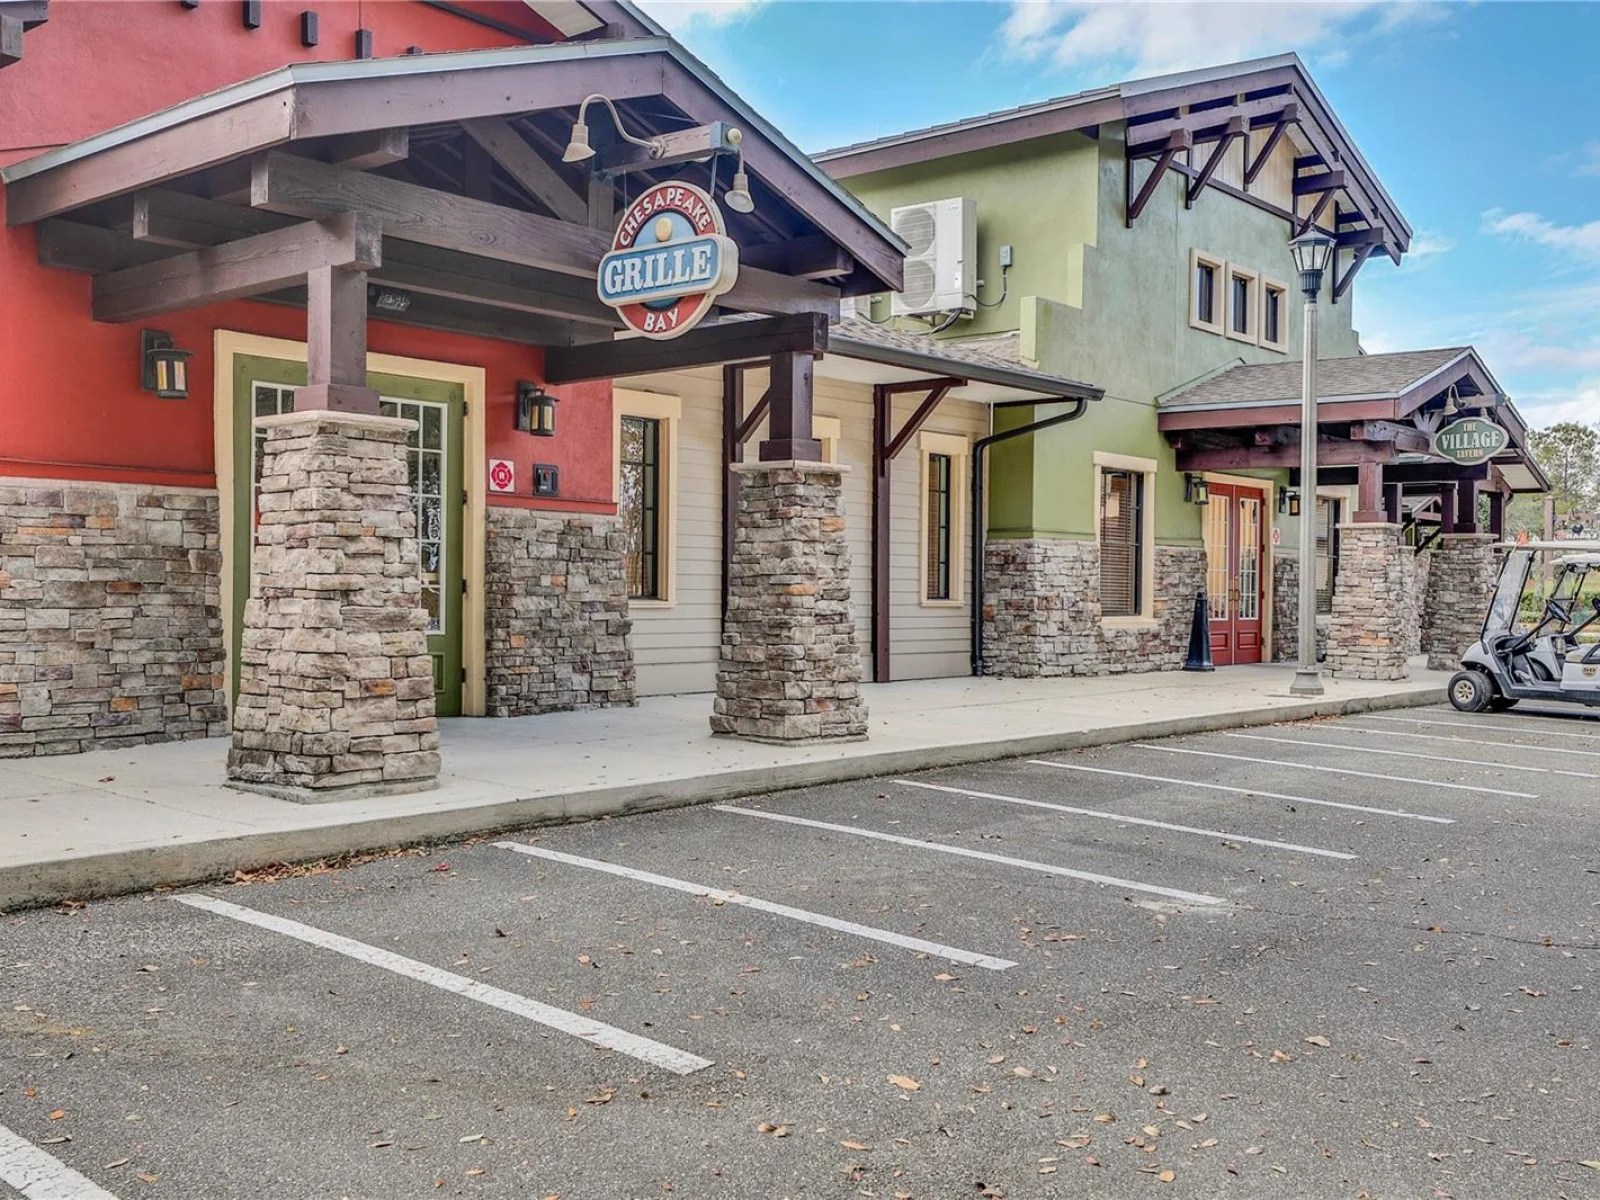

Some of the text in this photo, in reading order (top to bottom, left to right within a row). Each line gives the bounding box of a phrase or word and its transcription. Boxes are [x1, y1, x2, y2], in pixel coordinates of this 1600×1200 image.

[620, 188, 711, 246] CHESAPEAKE
[604, 245, 712, 294] GRILLE
[644, 307, 679, 331] BAY
[1463, 423, 1476, 431] THE
[1441, 431, 1500, 449] VILLAGE
[1456, 449, 1484, 458] TAVERN
[499, 471, 505, 480] R
